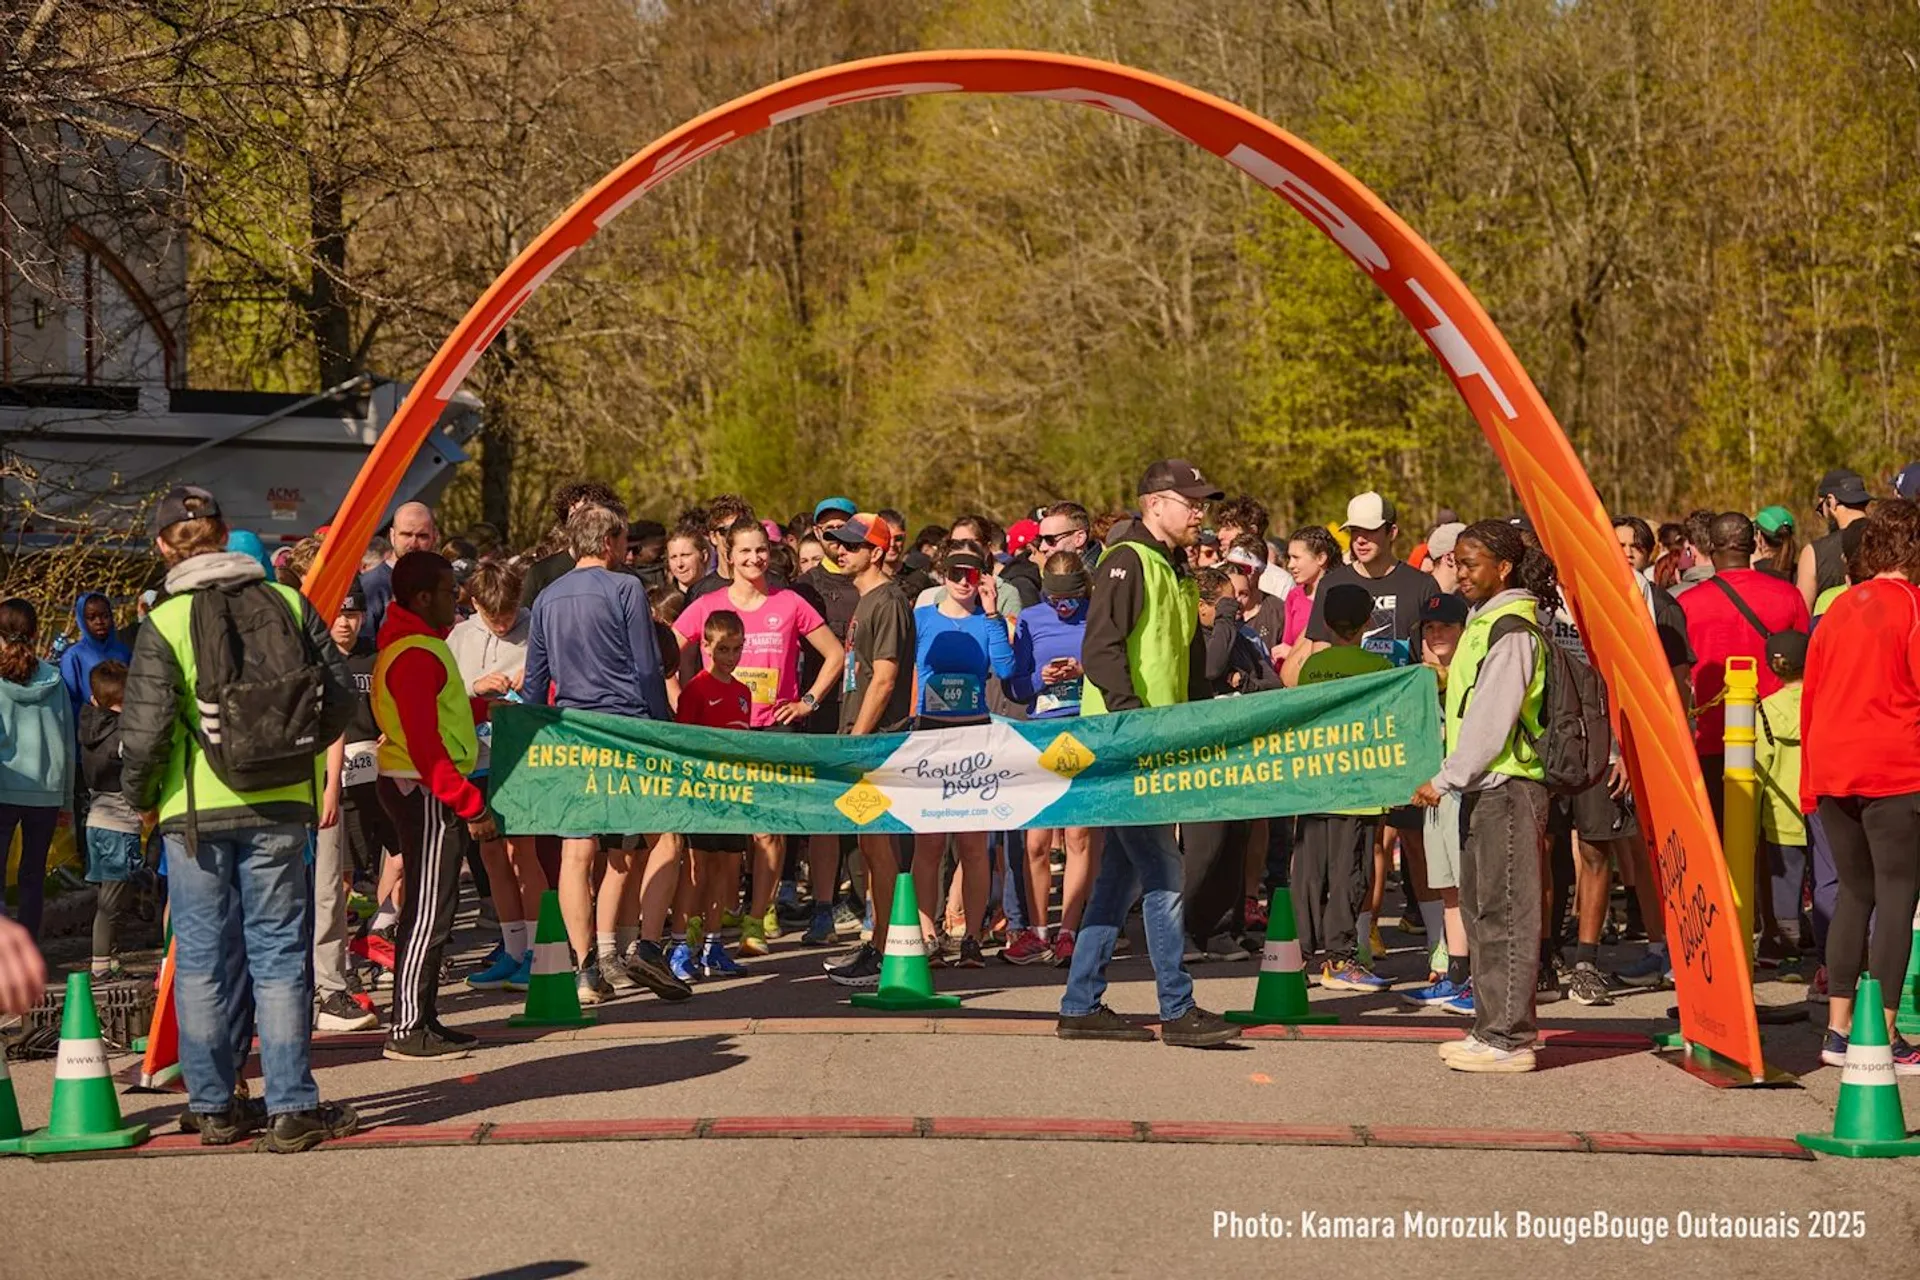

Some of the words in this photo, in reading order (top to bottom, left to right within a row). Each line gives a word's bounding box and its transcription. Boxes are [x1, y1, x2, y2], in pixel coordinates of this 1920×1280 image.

[943, 687, 963, 702] 669
[1138, 744, 1228, 770] MISSION
[1252, 721, 1365, 758] PRÉVENIR
[1373, 715, 1396, 740] LE
[347, 756, 372, 771] 3428
[528, 745, 637, 769] ENSEMBLE
[645, 756, 673, 773] ON
[682, 759, 817, 784] S'ACCROCHE
[1134, 760, 1284, 796] DÉCROCHAGE
[1292, 743, 1407, 779] PHYSIQUE
[585, 767, 598, 794] À
[607, 773, 631, 796] LA
[640, 775, 672, 797] VIE
[678, 779, 754, 804] ACTIVE
[921, 807, 989, 819] BougeBouge.com
